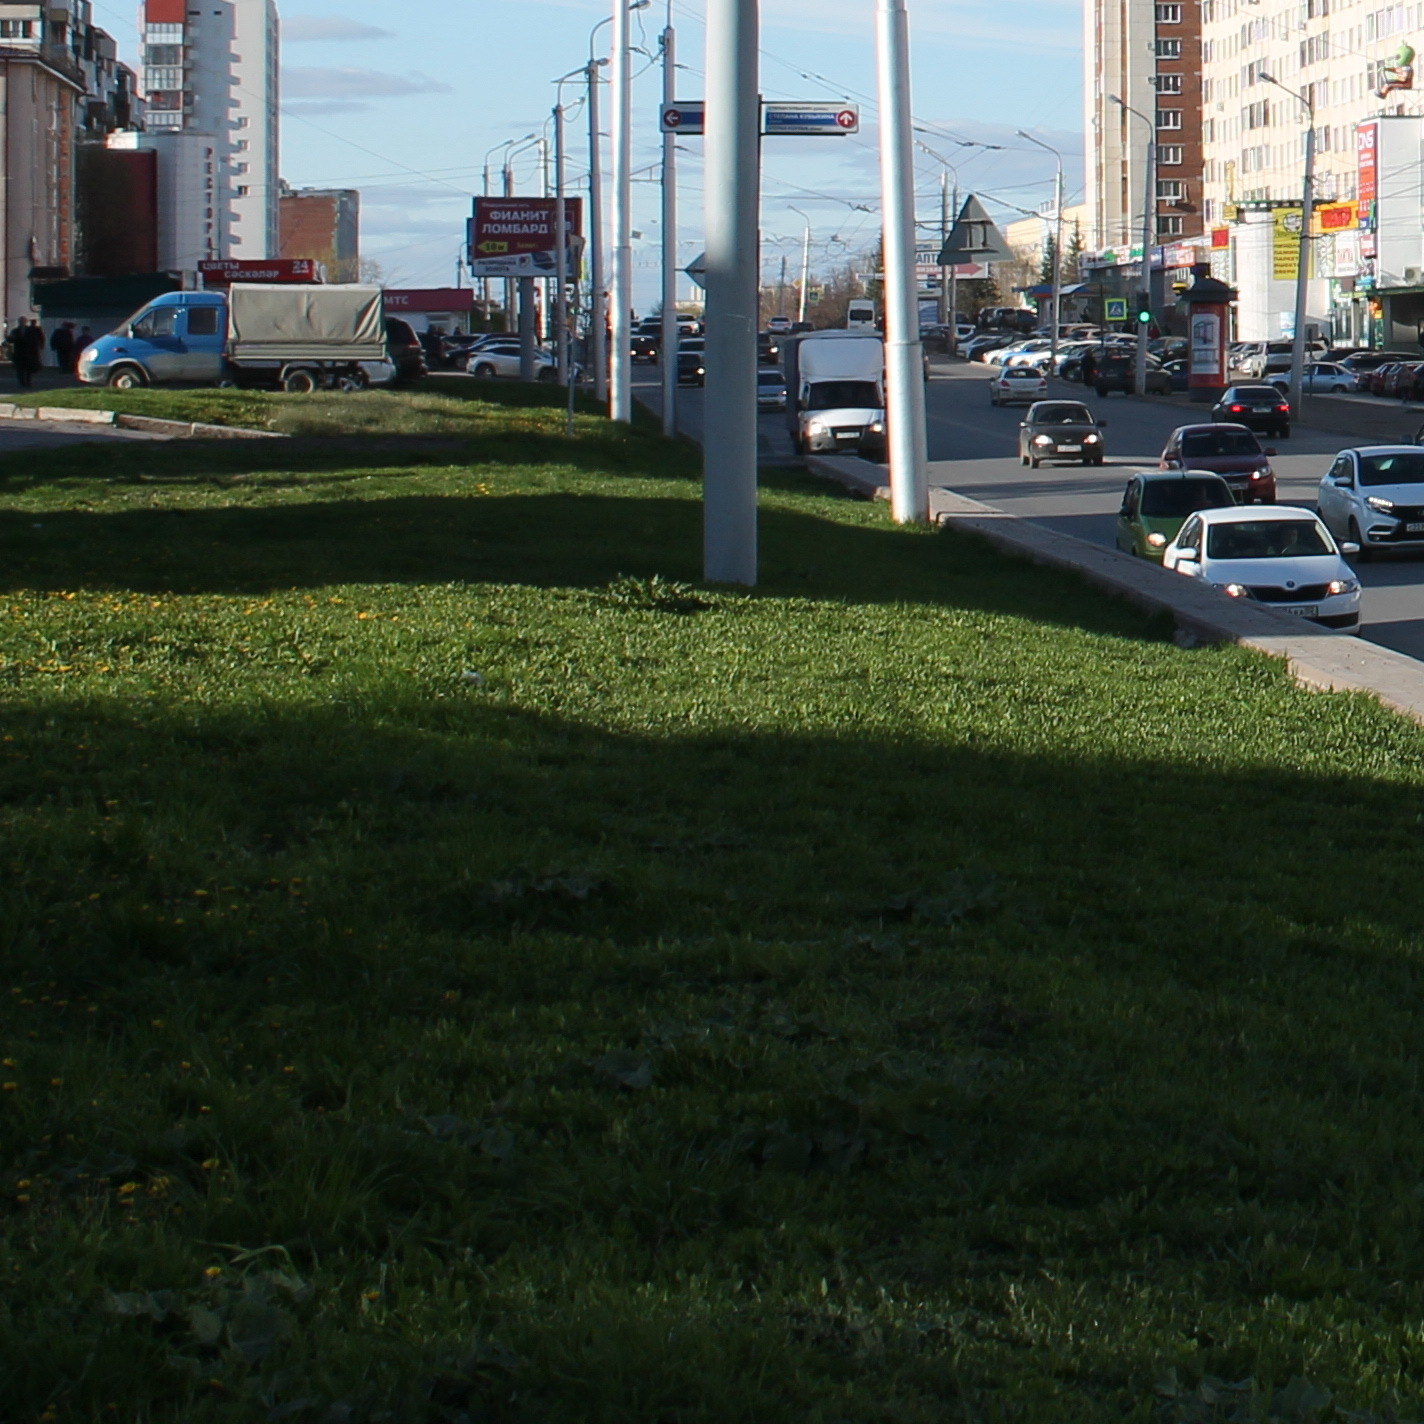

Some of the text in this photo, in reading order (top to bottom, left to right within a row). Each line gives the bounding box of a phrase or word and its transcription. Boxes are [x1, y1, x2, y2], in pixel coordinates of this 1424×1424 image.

[489, 210, 549, 221] ФИАНИТ
[482, 223, 549, 234] ЛОМБАРД
[202, 260, 309, 271] ЦВЕТЫ 24
[383, 294, 409, 305] МТС
